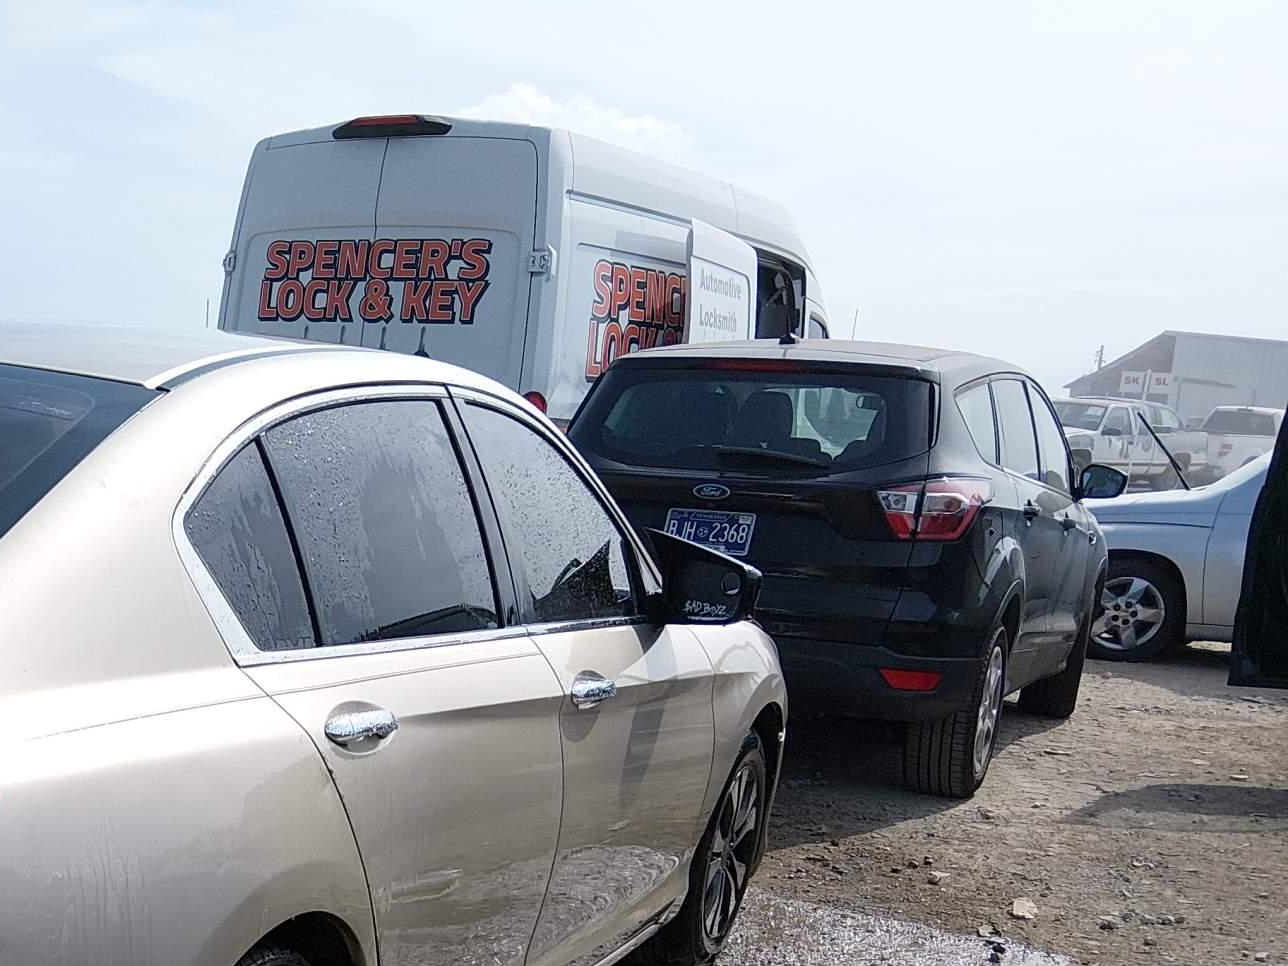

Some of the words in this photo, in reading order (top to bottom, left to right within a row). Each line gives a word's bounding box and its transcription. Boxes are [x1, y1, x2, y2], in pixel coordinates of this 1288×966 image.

[264, 239, 492, 280] SPENCER'S
[699, 268, 742, 300] Automotive
[258, 278, 357, 322] LOCK
[359, 278, 394, 323] &
[400, 280, 490, 323] KEY
[699, 303, 737, 333] Locksmith
[1124, 376, 1139, 384] SK
[1155, 377, 1169, 386] SL
[709, 523, 748, 543] 2368
